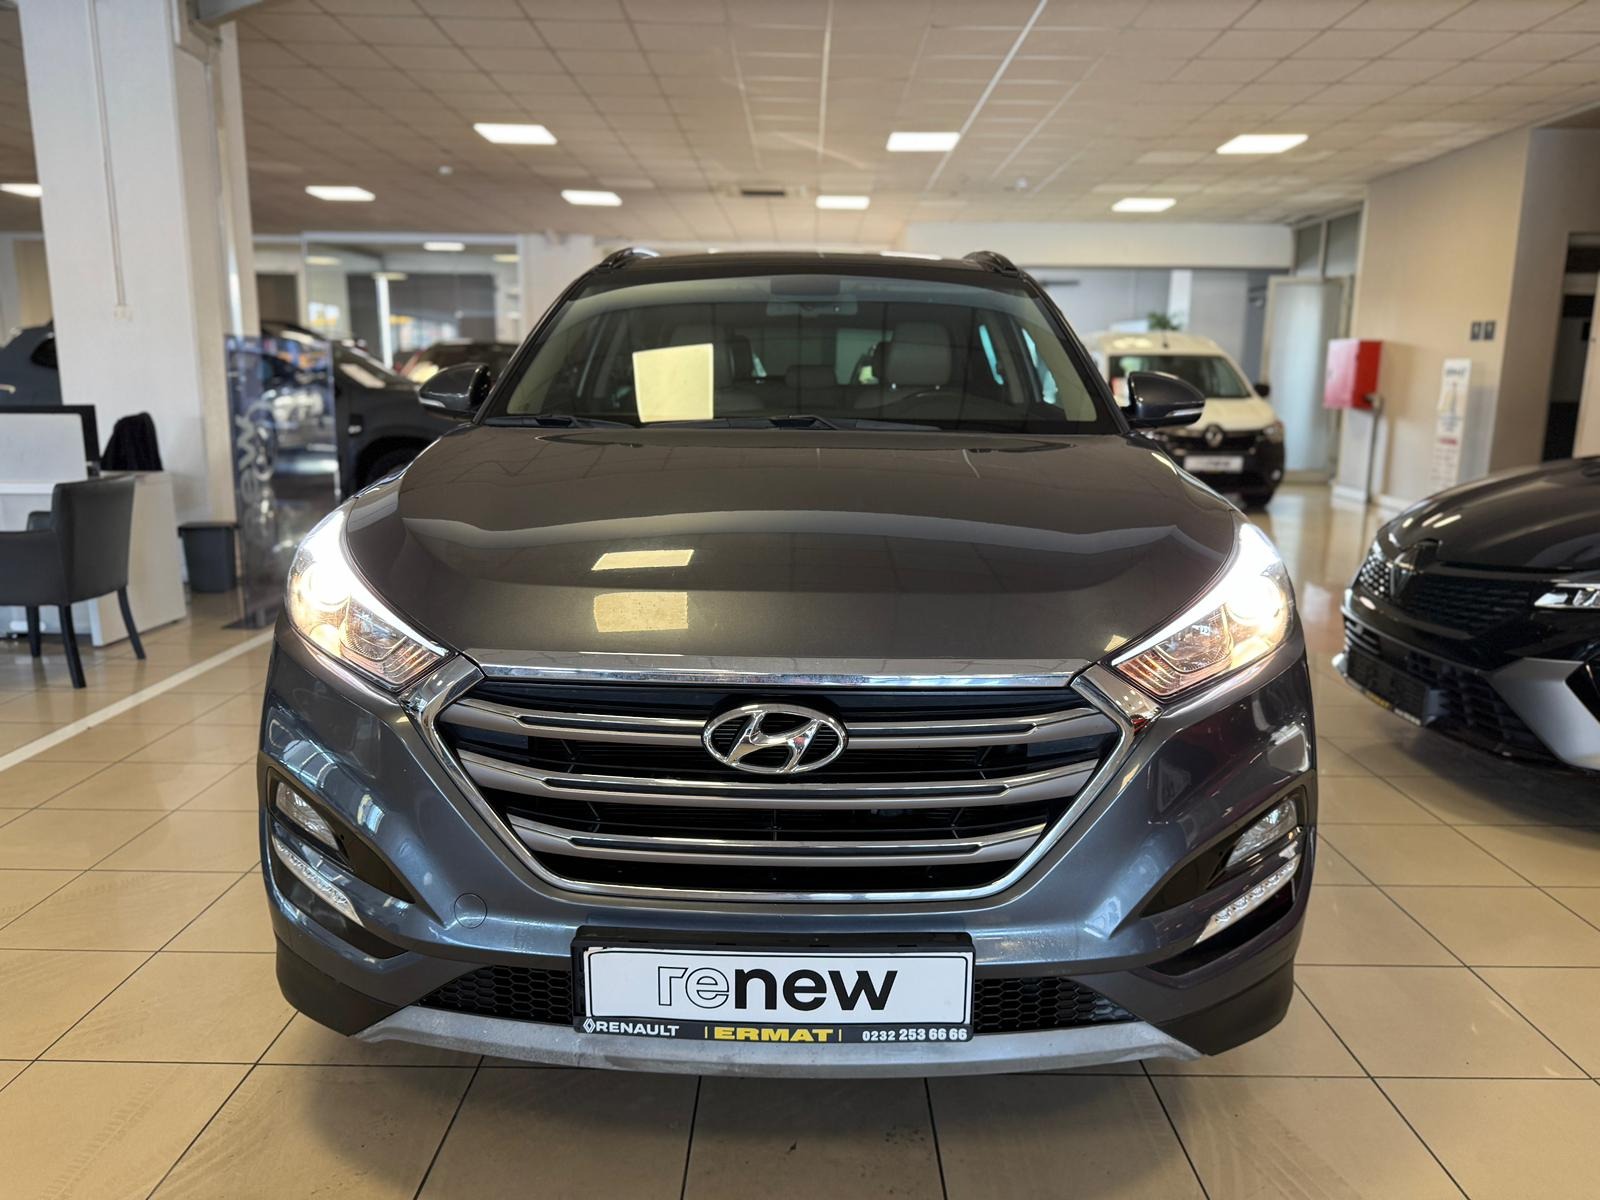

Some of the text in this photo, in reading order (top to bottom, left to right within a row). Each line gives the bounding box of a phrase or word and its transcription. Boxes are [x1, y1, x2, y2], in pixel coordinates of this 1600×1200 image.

[657, 965, 899, 1012] renew
[595, 1021, 680, 1037] RENAULT
[714, 1026, 834, 1042] ERMAT
[862, 1030, 896, 1042] 0232
[898, 1028, 927, 1041] 253
